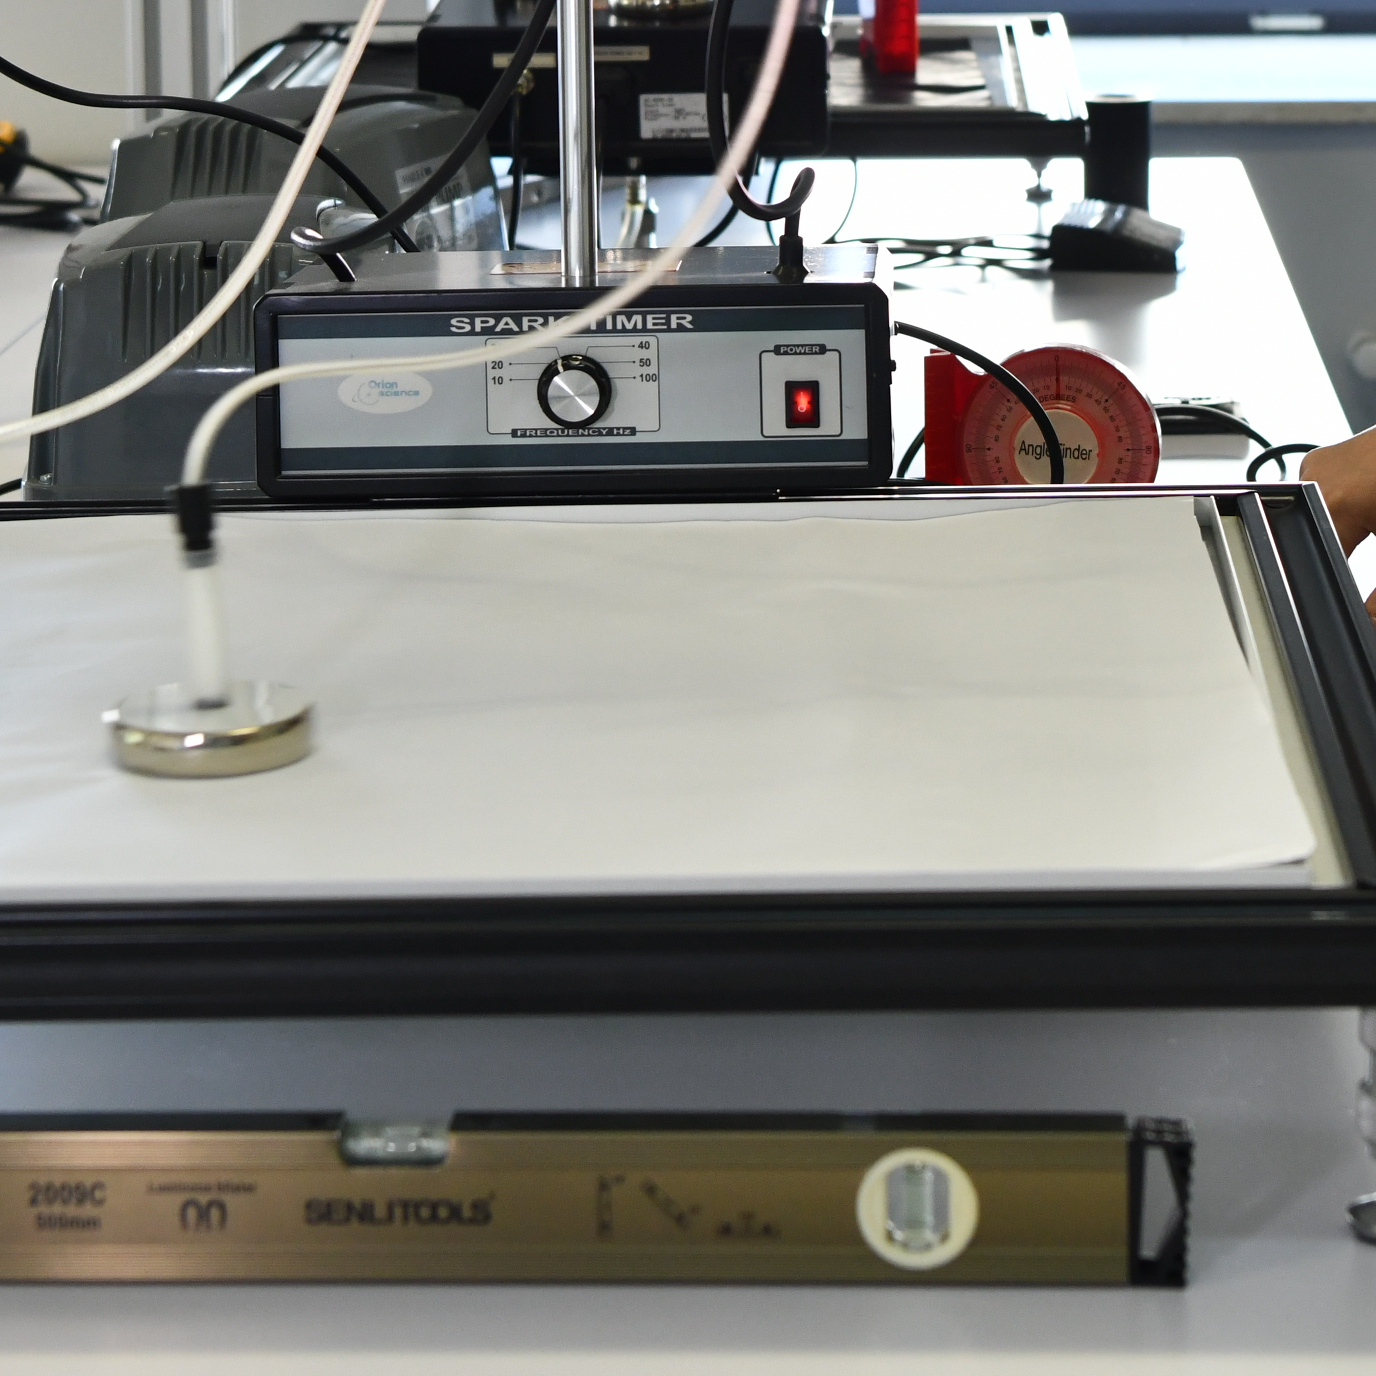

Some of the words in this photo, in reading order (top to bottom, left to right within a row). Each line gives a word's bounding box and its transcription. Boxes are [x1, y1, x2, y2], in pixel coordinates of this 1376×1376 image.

[449, 316, 570, 333] SPARK
[637, 341, 651, 350] 40
[780, 346, 820, 354] POWER
[491, 360, 504, 370] 20
[638, 358, 652, 367] 50
[491, 376, 504, 385] 10
[639, 373, 658, 383] 100
[368, 380, 398, 389] Orion
[1038, 394, 1077, 403] DEGREES
[516, 428, 608, 437] FREQUENCY
[613, 427, 631, 436] Hz
[1058, 443, 1093, 461] inder
